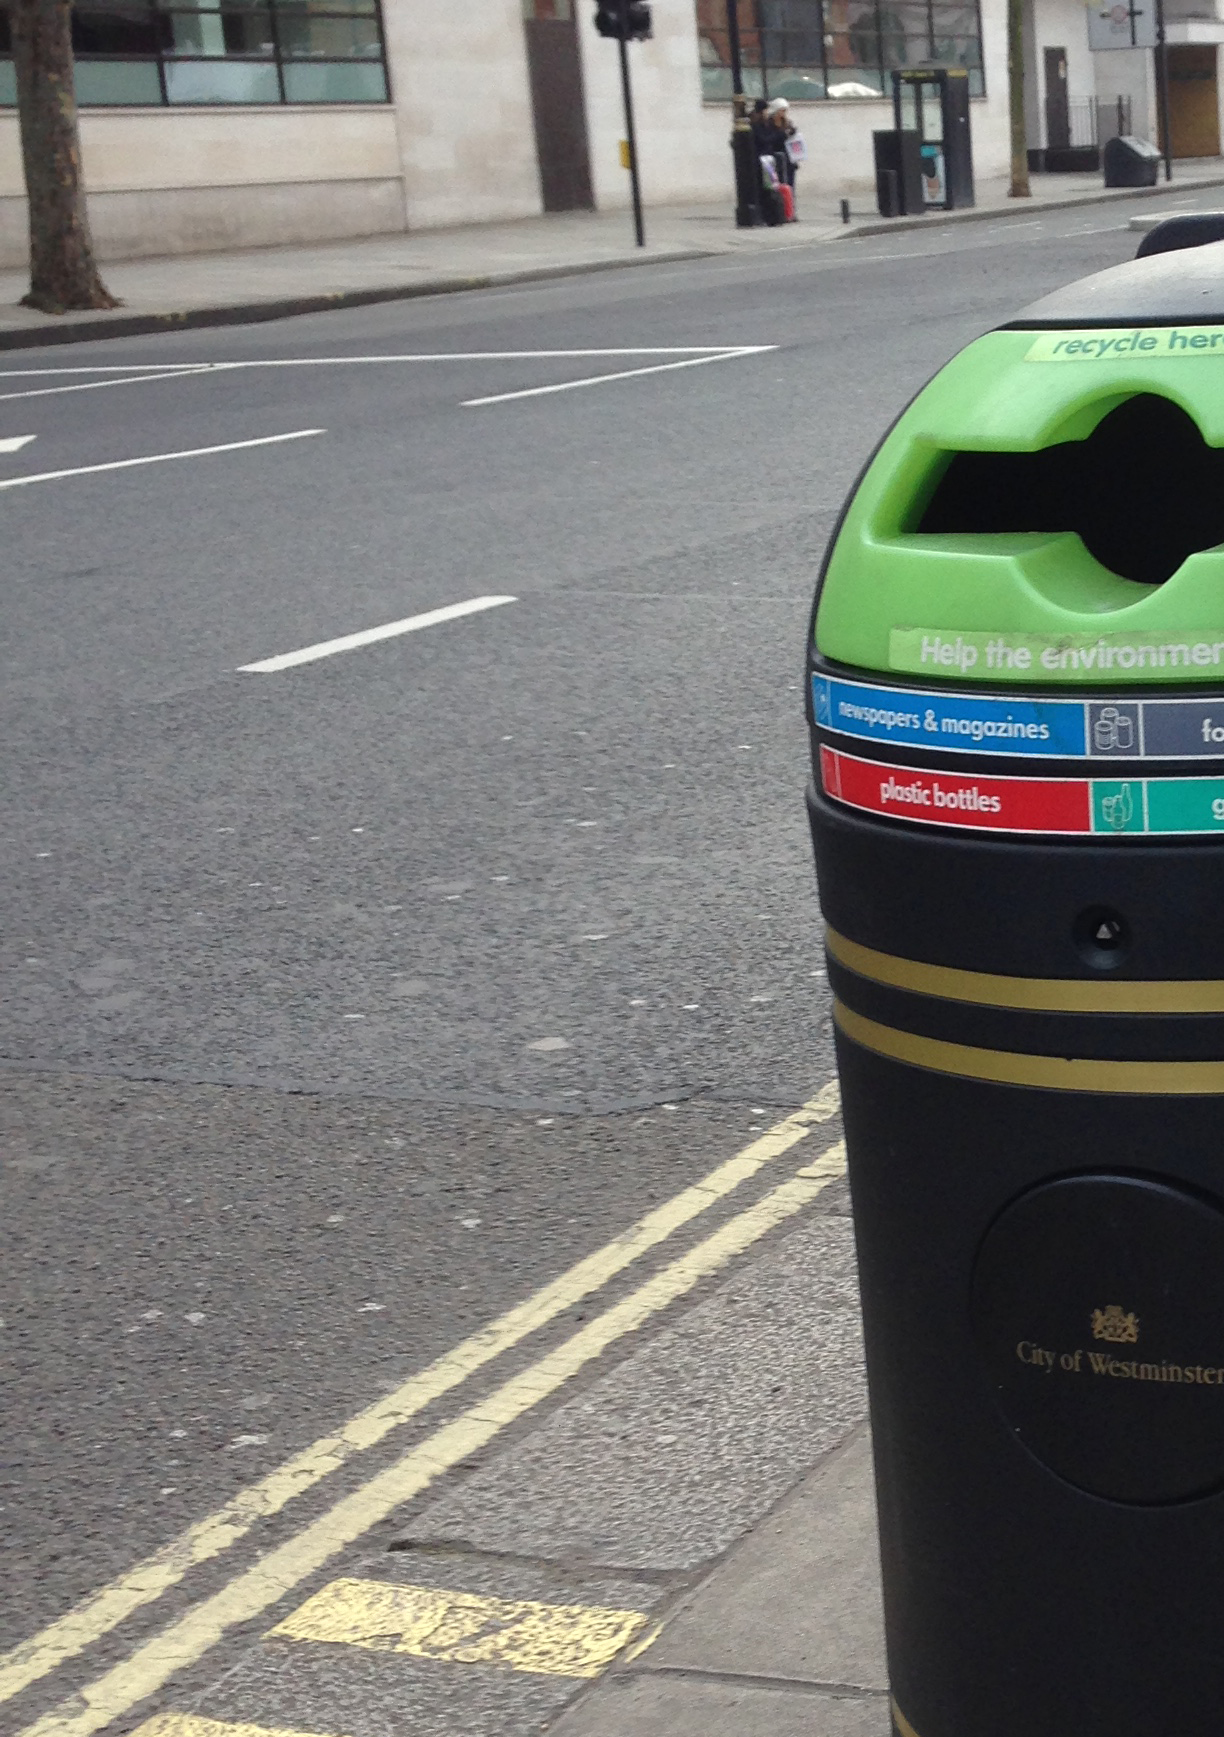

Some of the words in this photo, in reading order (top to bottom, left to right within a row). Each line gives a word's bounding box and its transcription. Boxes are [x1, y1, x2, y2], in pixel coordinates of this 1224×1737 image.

[1053, 330, 1158, 357] recycle
[921, 636, 978, 672] Help
[985, 638, 1031, 669] the
[838, 701, 921, 730] newspapers
[924, 710, 939, 732] &
[941, 716, 1050, 741] magazines
[880, 777, 931, 803] plastic
[933, 783, 1001, 813] bottles
[1016, 1341, 1056, 1373] City
[1060, 1350, 1083, 1372] of
